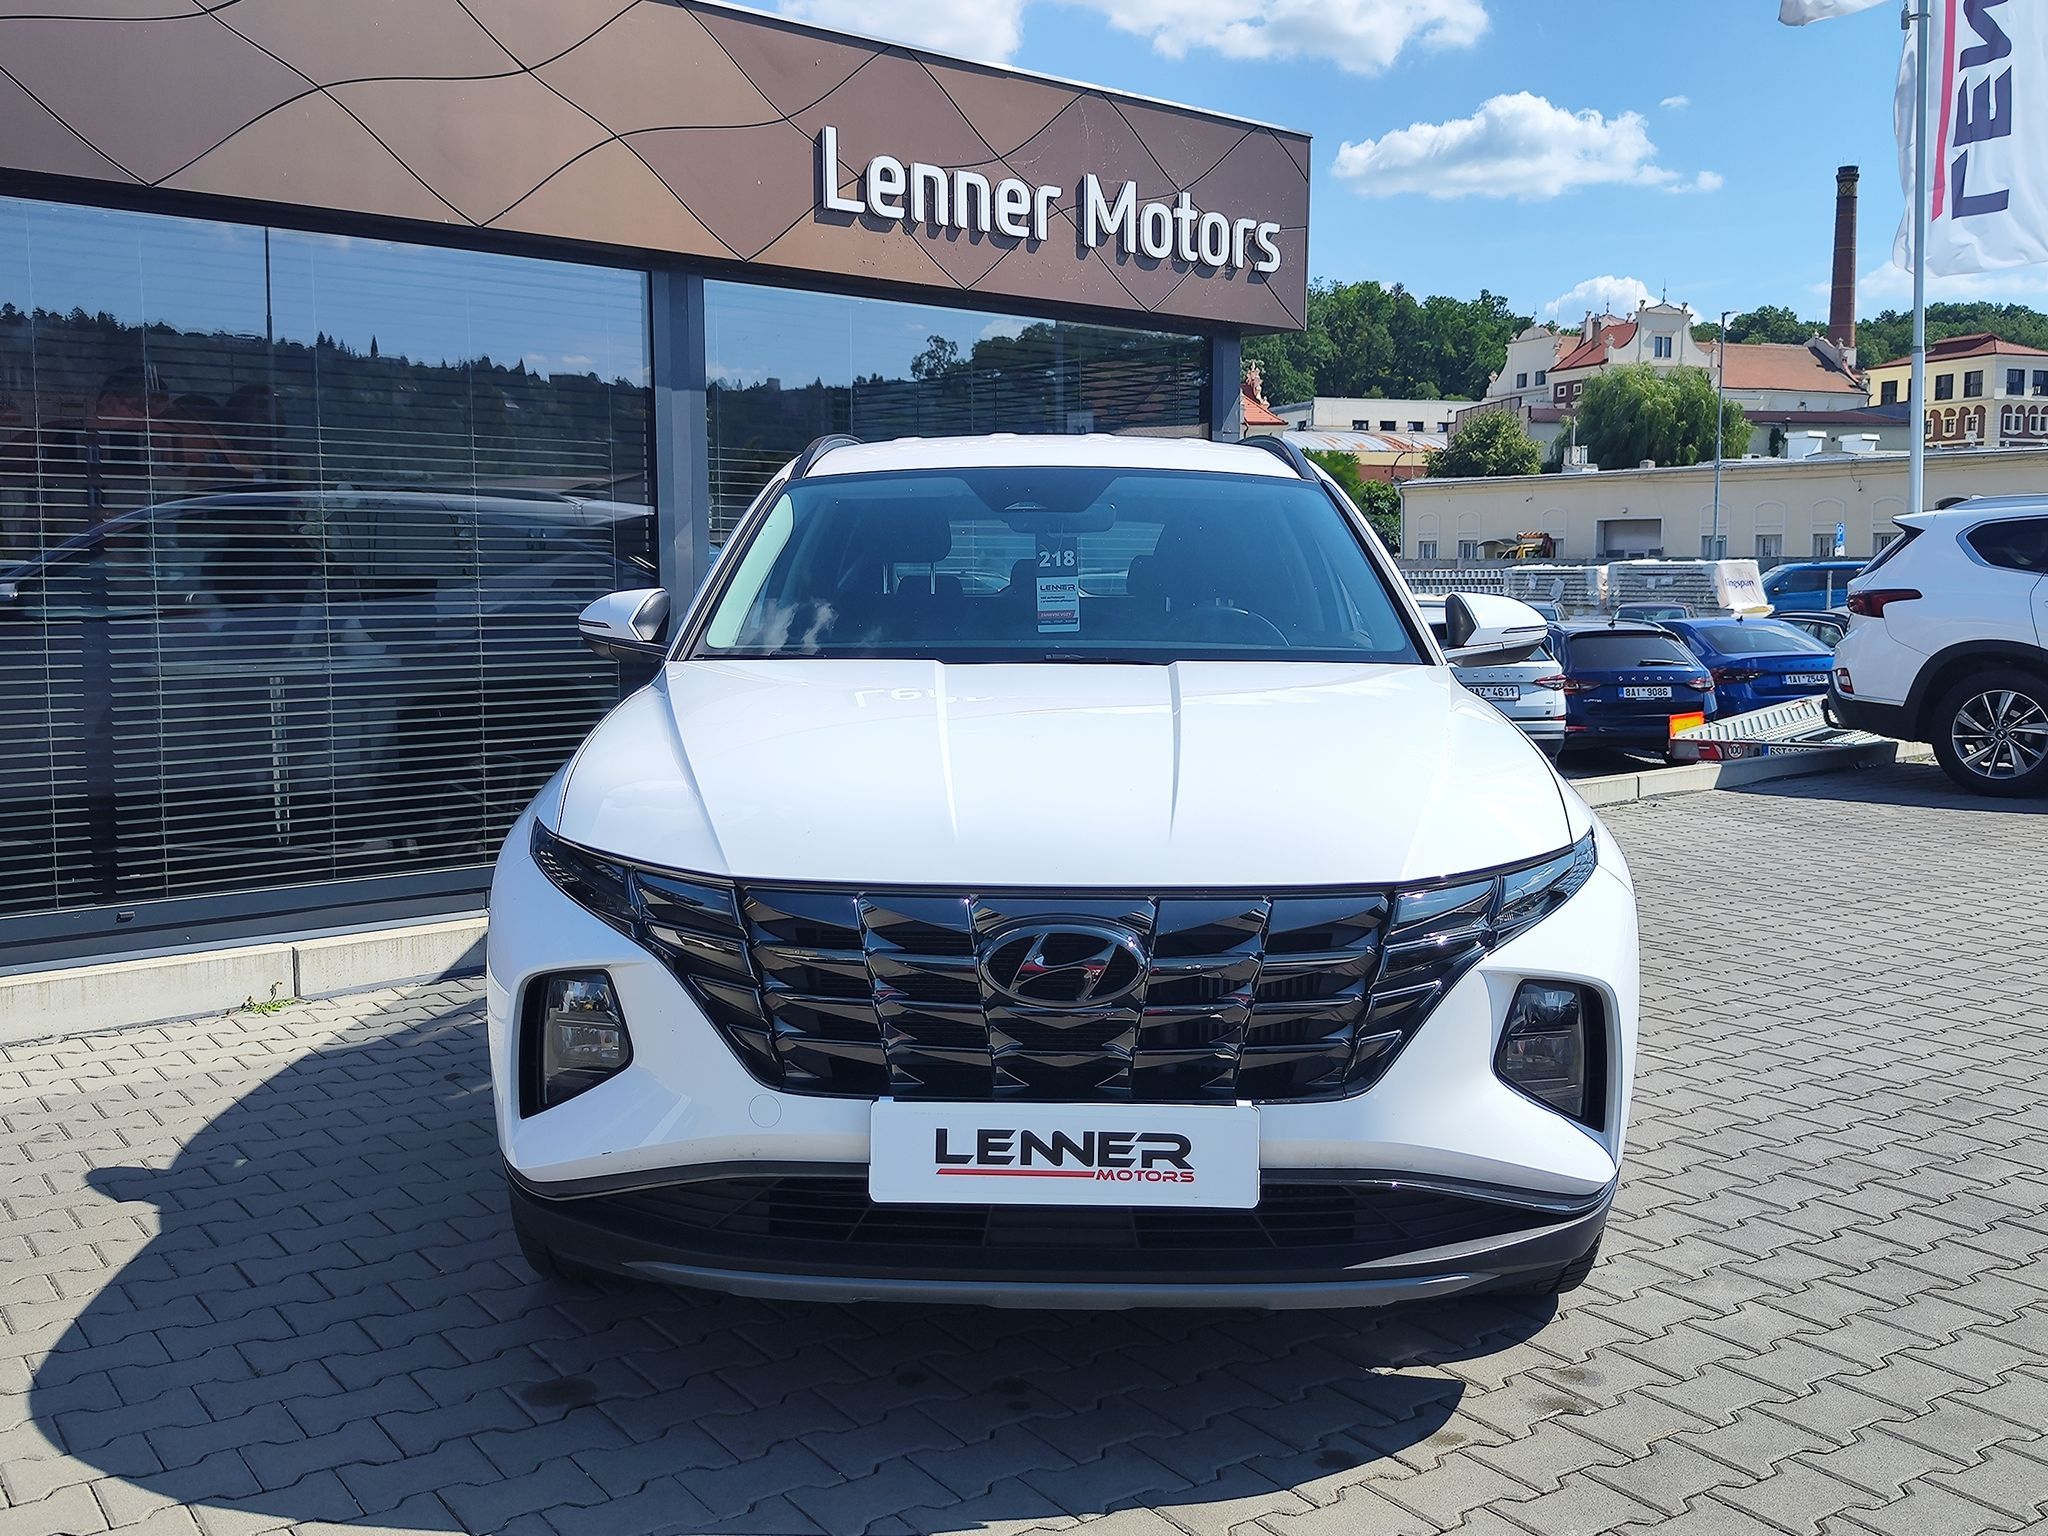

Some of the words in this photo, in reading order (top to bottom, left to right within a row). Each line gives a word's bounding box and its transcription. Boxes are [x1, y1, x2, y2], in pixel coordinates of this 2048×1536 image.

[820, 126, 1062, 242] Lenner
[1083, 172, 1281, 273] Motors
[1039, 550, 1075, 567] 218
[1493, 687, 1515, 696] 4611
[1625, 688, 1640, 697] 8AI
[1647, 687, 1668, 696] 9086
[935, 1128, 1194, 1169] LENNER
[1095, 1169, 1195, 1183] MOTORS
